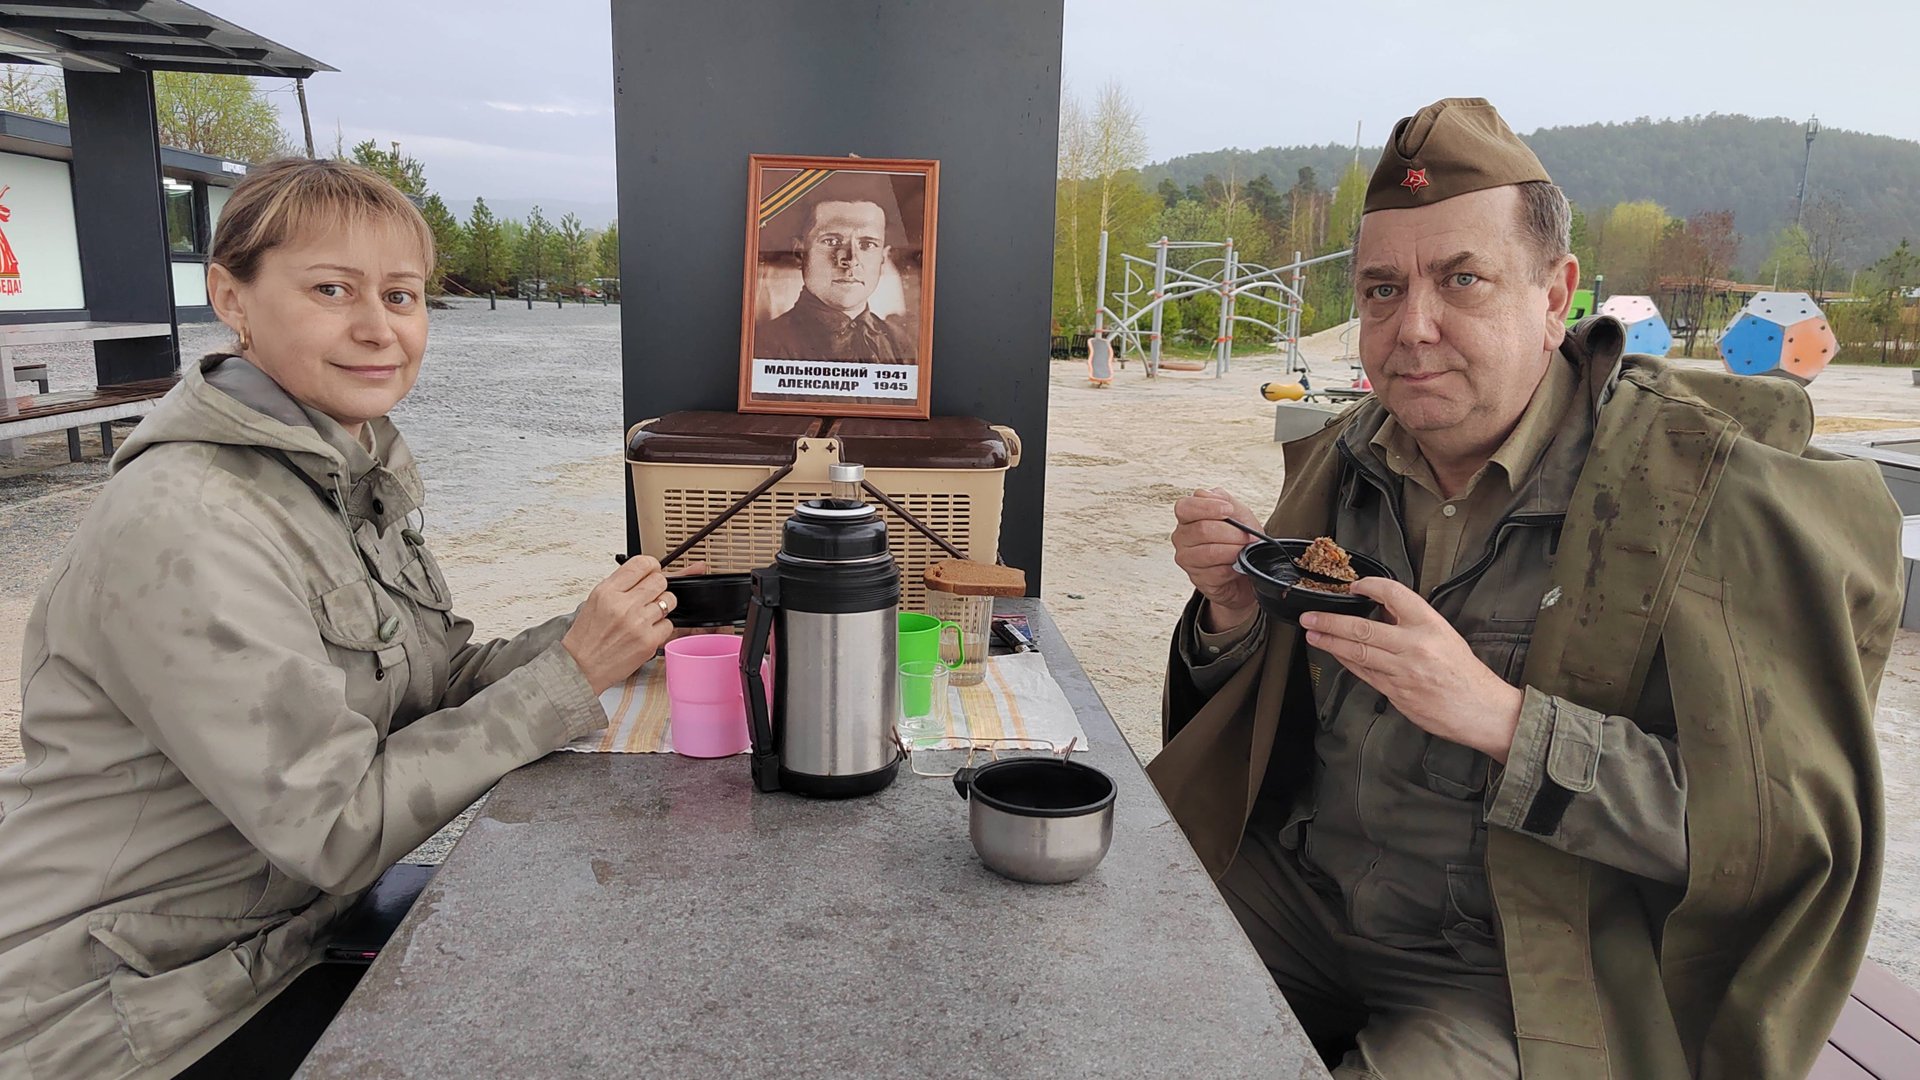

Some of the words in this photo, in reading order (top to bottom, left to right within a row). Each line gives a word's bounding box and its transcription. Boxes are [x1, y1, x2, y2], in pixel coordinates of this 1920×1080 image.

[0, 280, 22, 295] ЕДА!
[764, 365, 868, 378] МАЛЬКОВСКИЙ
[874, 370, 907, 380] 1941
[777, 378, 860, 391] АЛЕКСАНДР
[873, 381, 908, 391] 1945
